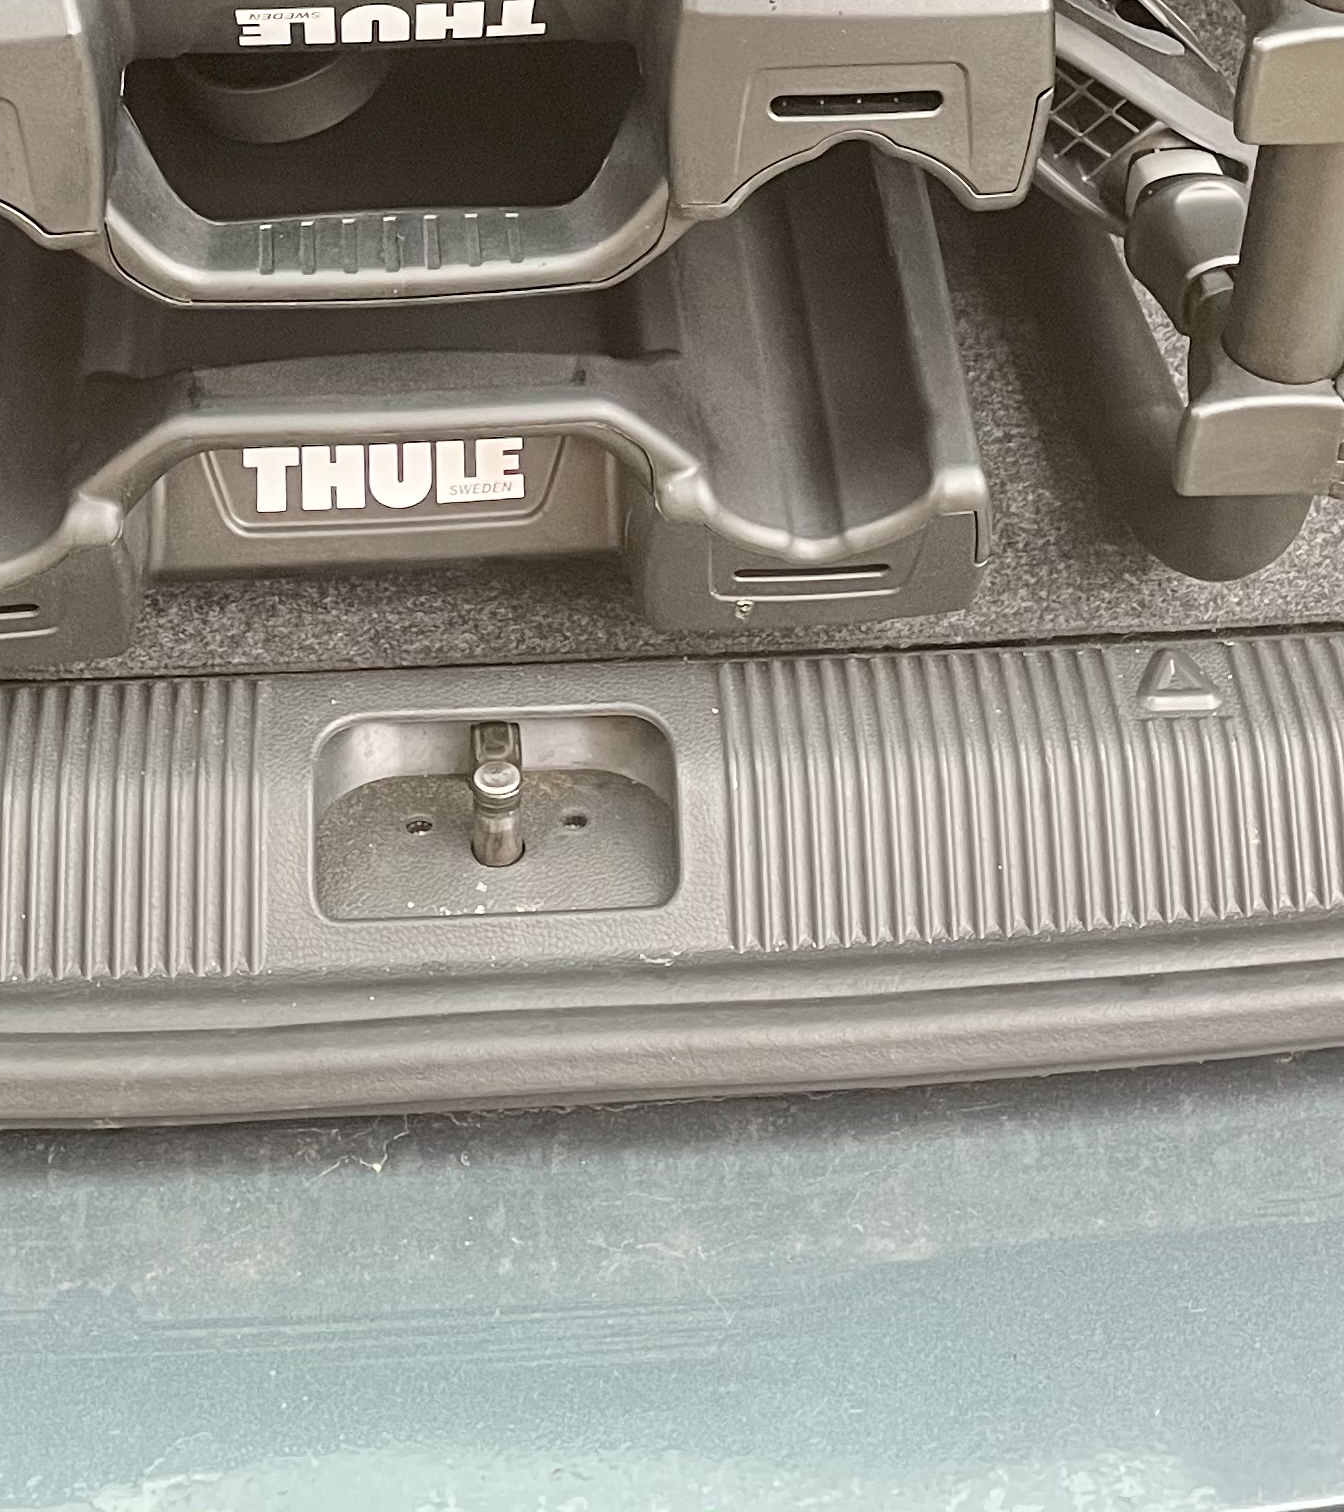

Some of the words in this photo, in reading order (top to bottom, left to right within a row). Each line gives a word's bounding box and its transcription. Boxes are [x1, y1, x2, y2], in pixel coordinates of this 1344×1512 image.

[248, 11, 321, 21] SWEDEN
[242, 436, 526, 513] THULE
[449, 481, 513, 496] SWEDEN
